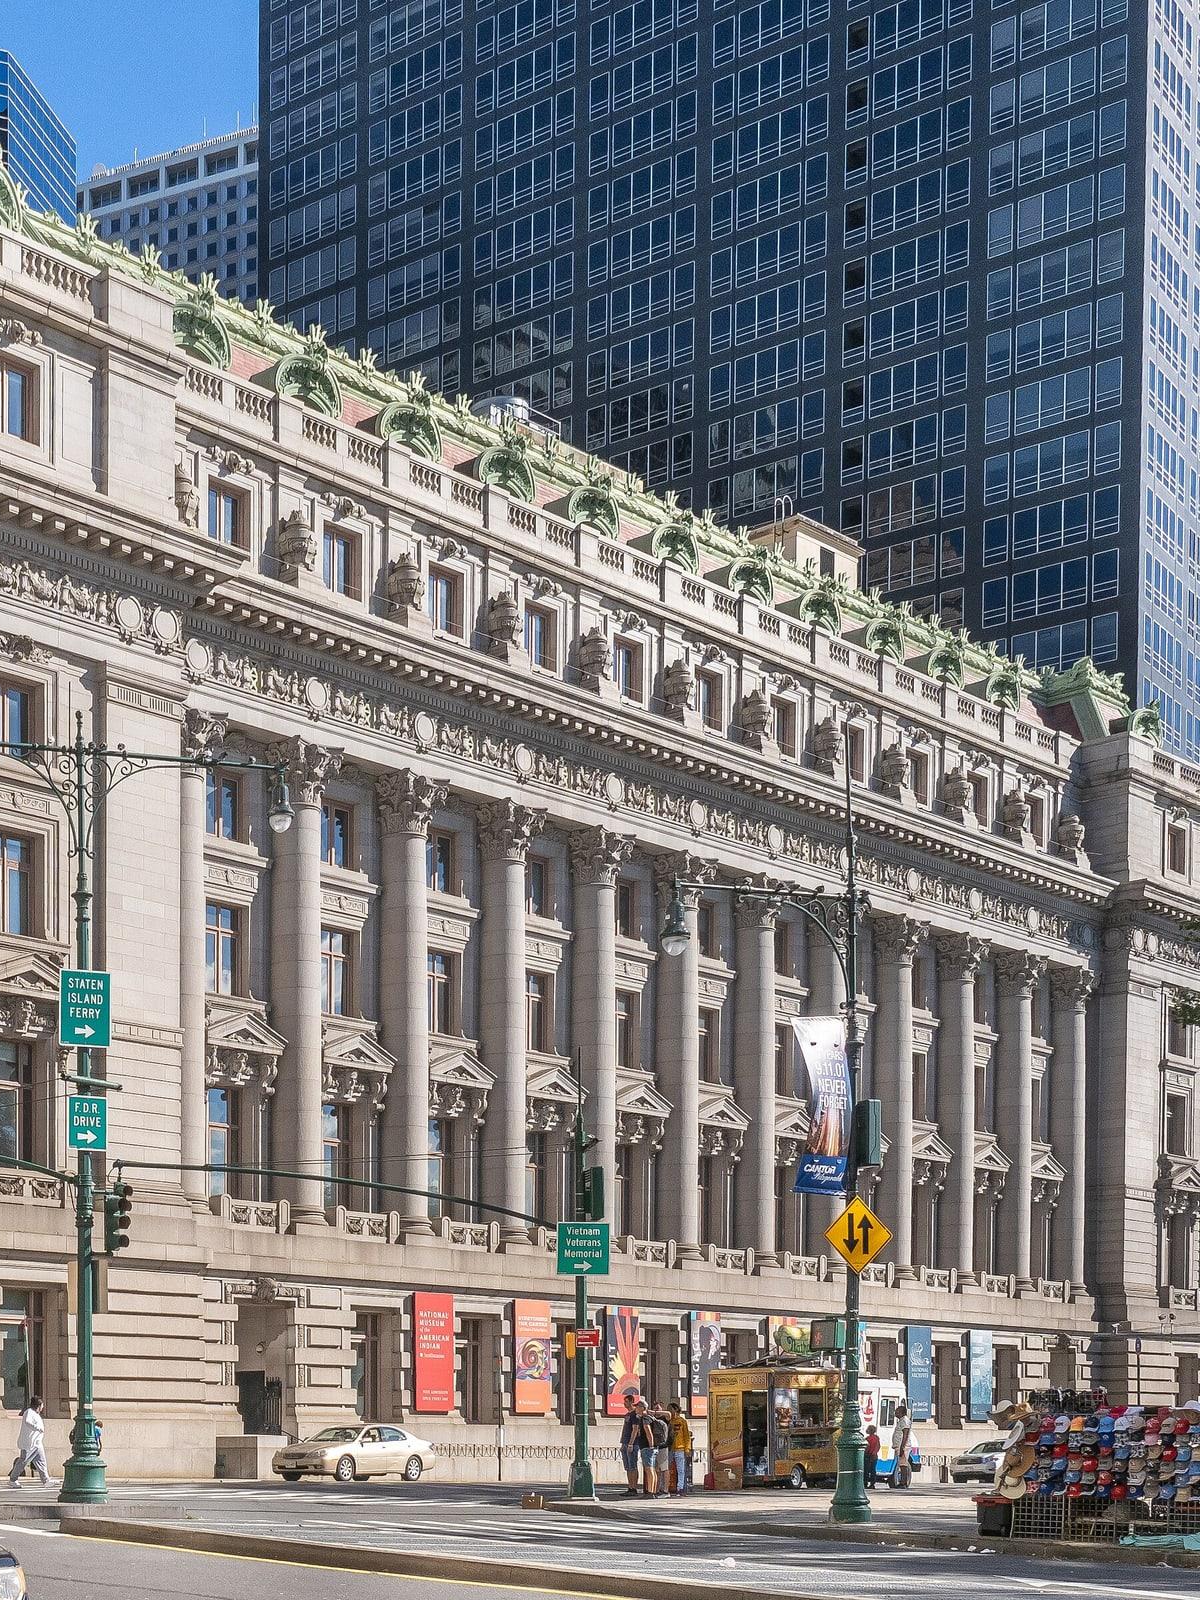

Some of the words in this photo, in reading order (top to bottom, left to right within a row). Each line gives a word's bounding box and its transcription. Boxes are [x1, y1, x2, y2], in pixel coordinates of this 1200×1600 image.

[68, 977, 104, 991] STATEN
[67, 992, 103, 1005] ISLAND
[69, 1007, 101, 1019] FERRY
[815, 1061, 846, 1078] 9.11.01
[818, 1078, 847, 1095] NEVER
[74, 1101, 100, 1114] F.D.R.
[819, 1094, 848, 1110] FORGET
[73, 1115, 102, 1128] DRIVE
[803, 1163, 837, 1175] CANTOR
[566, 1226, 601, 1236] Vietnam
[565, 1237, 602, 1247] Veterans
[564, 1249, 603, 1258] Memorial
[419, 1311, 449, 1319] NATIONAL
[419, 1319, 445, 1327] MUSEUM
[419, 1334, 450, 1342] AMERICAN
[419, 1342, 441, 1350] INDIAN
[692, 1333, 700, 1394] ENGAGE
